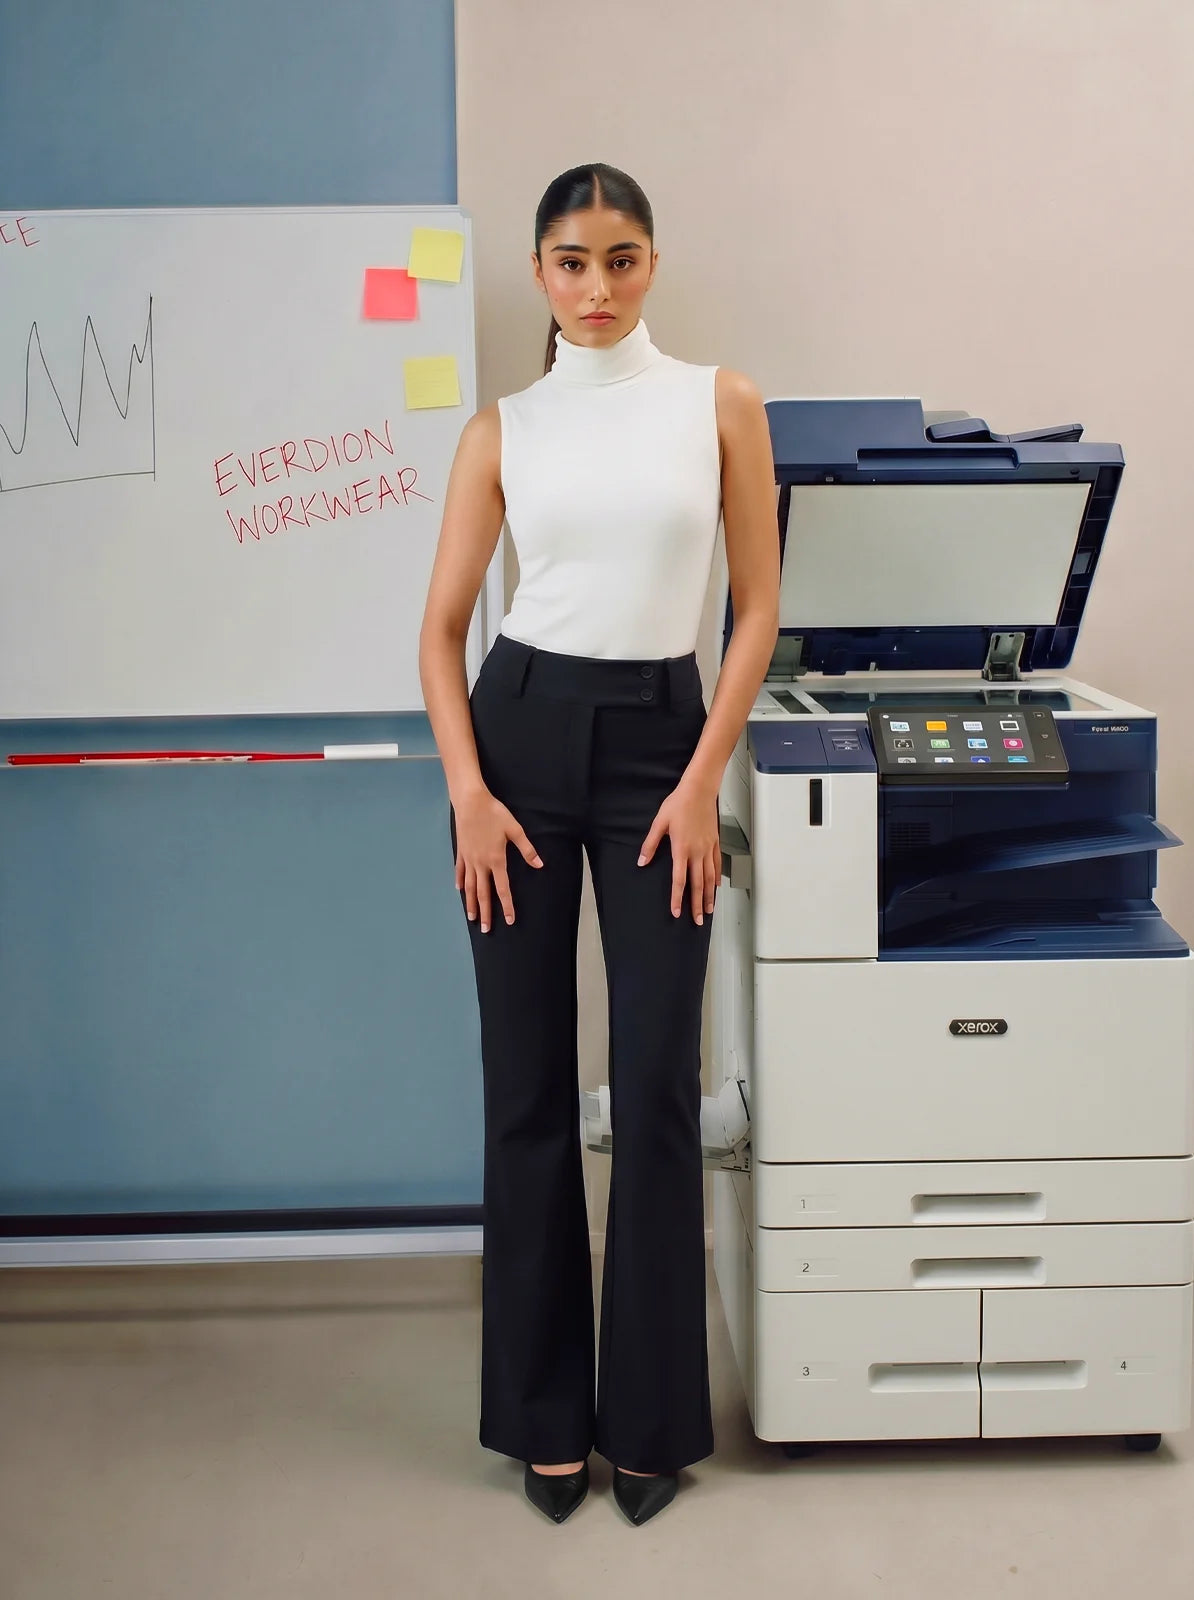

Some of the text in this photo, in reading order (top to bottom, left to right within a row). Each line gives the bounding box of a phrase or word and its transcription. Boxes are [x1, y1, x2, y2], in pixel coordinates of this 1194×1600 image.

[213, 420, 395, 496] EVERDION
[226, 467, 434, 544] WORKWEAR
[957, 1022, 998, 1033] xerox
[800, 1199, 806, 1209] 1
[802, 1262, 810, 1273] 2
[1120, 1360, 1128, 1371] 4
[802, 1366, 810, 1377] 3
